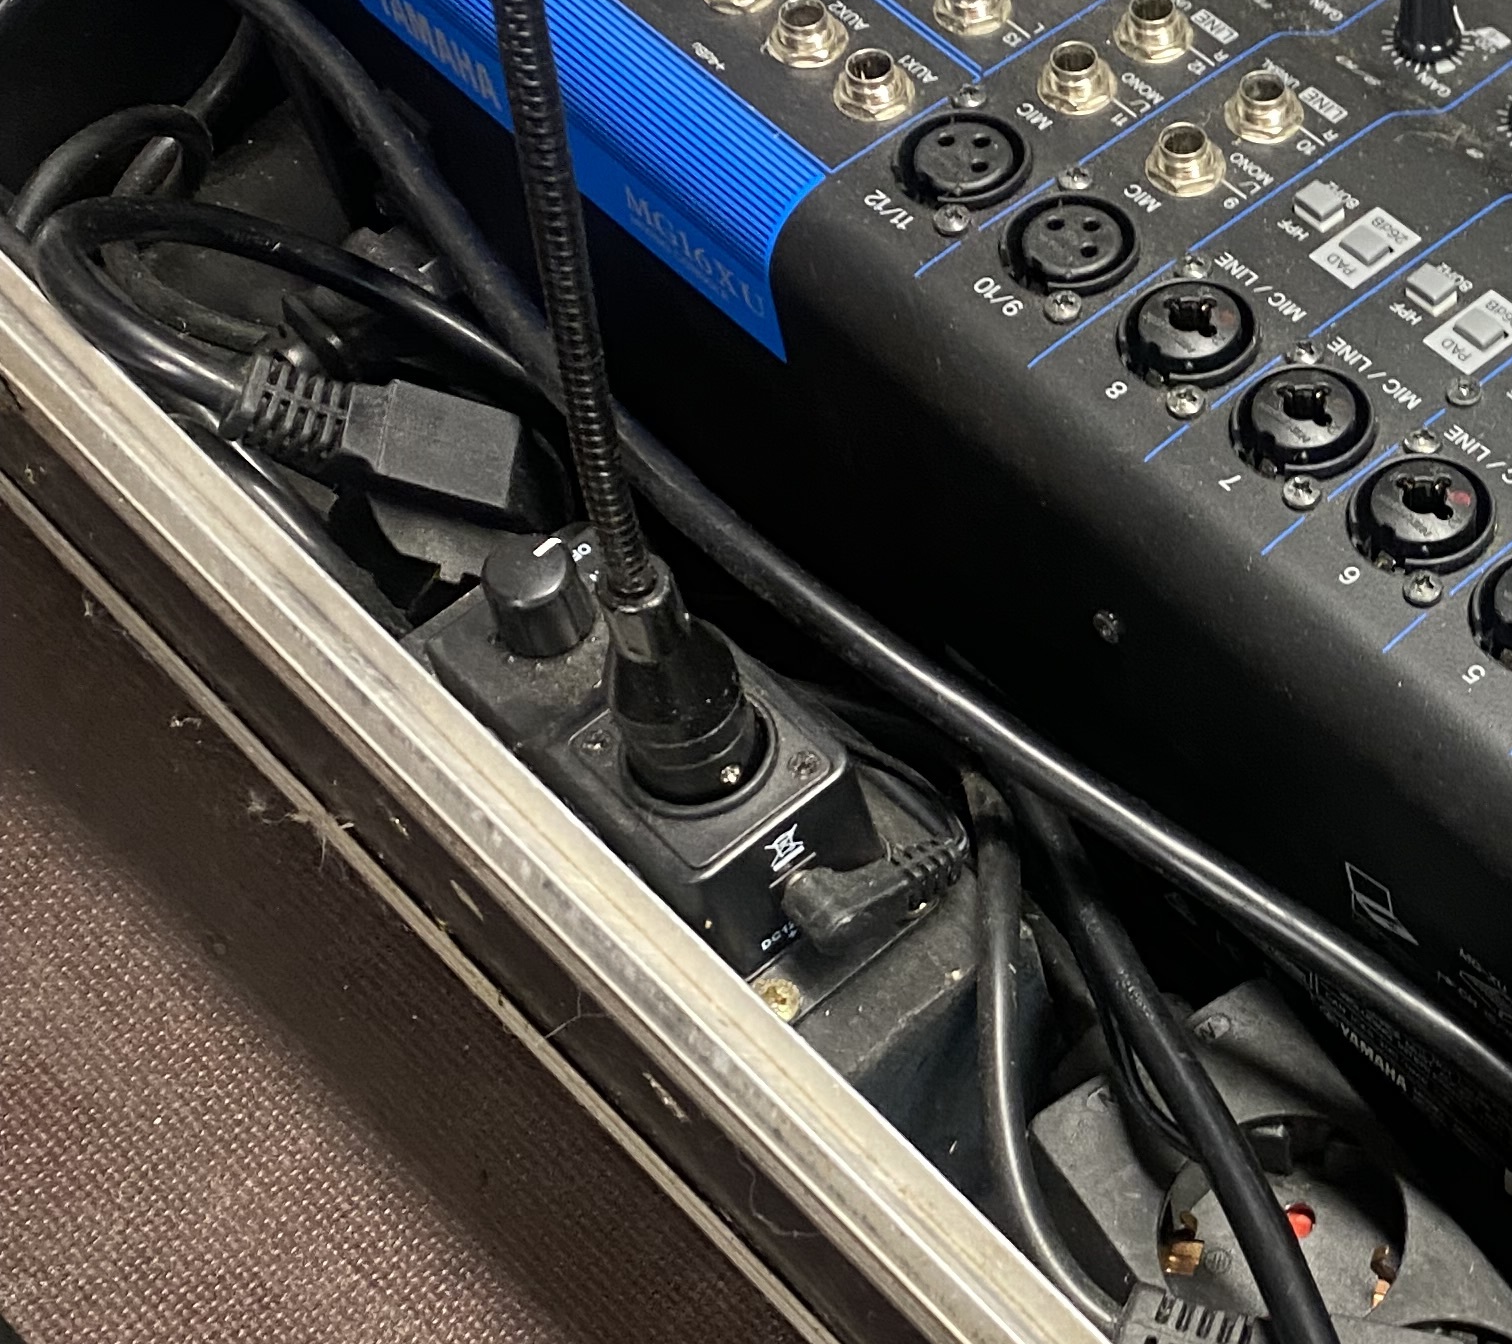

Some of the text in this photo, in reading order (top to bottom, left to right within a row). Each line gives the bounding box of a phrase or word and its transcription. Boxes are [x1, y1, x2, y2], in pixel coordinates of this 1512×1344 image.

[828, 1, 869, 30] AUX2
[1194, 9, 1237, 42] LINE
[898, 54, 938, 83] AUX1
[1121, 72, 1164, 104] MONO
[1416, 71, 1451, 98] GAIN
[1016, 102, 1053, 130] MIC
[1301, 89, 1346, 121] LINE
[1296, 139, 1316, 155] 10
[1230, 152, 1274, 186] MONO
[863, 189, 915, 229] 11/12
[1123, 184, 1162, 213] MIC
[1223, 197, 1239, 209] 9
[1277, 218, 1309, 241] HPF
[1371, 216, 1409, 245] 26dB
[625, 186, 765, 318] MG16XU
[1326, 253, 1355, 276] PAD
[1214, 252, 1259, 287] LINE
[973, 276, 1024, 316] 9/10
[1268, 292, 1307, 322] MIC
[1389, 301, 1422, 325] HPF
[1327, 337, 1373, 373] LINE
[1440, 338, 1470, 361] PAD
[1104, 380, 1127, 399] 8
[1382, 378, 1422, 410] MIC
[1443, 424, 1491, 462] LINE
[1218, 474, 1242, 491] 7
[1339, 566, 1360, 585] 6
[1462, 665, 1486, 685] 5
[1340, 1023, 1407, 1092] YAMAHA
